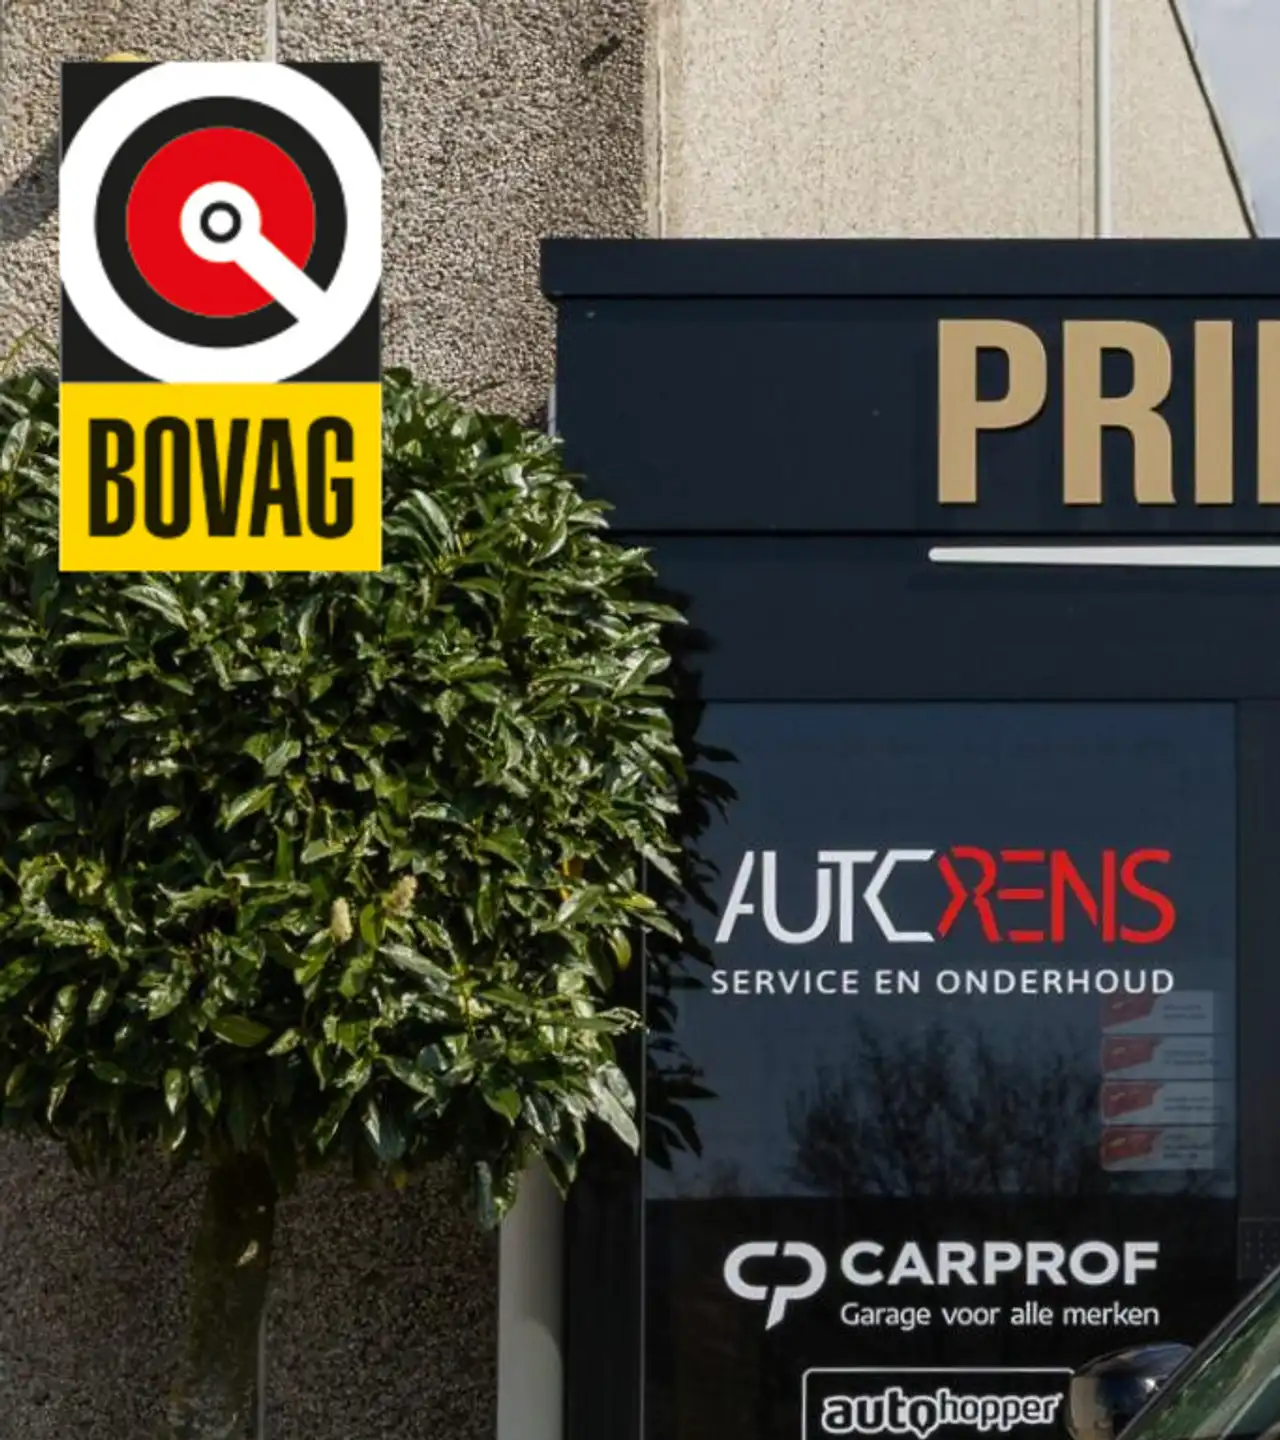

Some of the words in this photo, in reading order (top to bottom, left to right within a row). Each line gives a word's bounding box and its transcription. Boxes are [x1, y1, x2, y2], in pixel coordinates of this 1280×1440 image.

[711, 968, 860, 996] SERVICE
[874, 968, 920, 996] EN
[935, 967, 1176, 995] ONDERHOUD
[840, 1240, 1160, 1287] CARPROF
[840, 1302, 932, 1332] Garage
[940, 1306, 1001, 1327] voor
[1009, 1301, 1054, 1327] alle
[1062, 1301, 1160, 1327] merken
[821, 1386, 1060, 1440] autohopper
